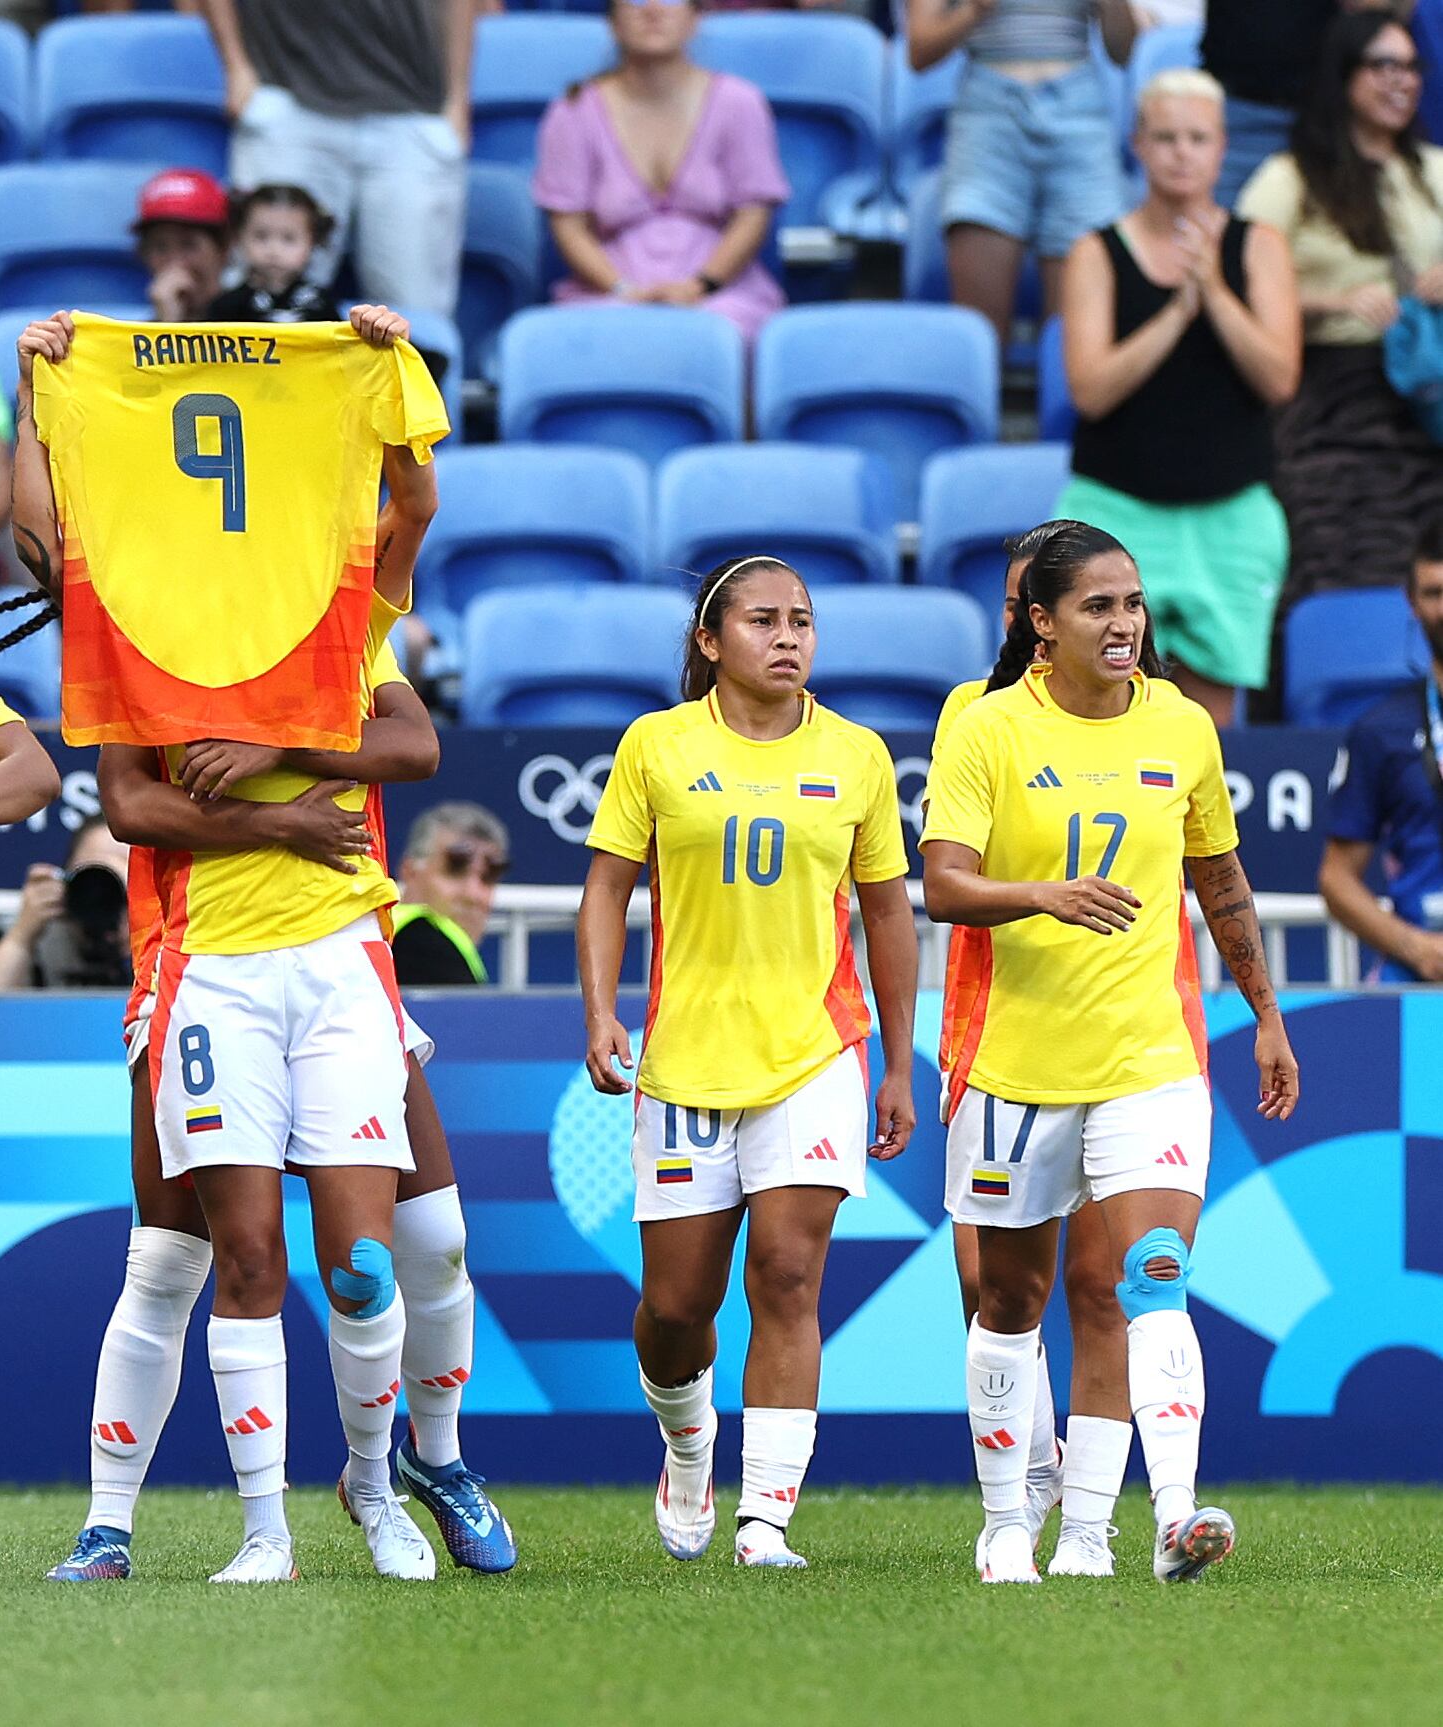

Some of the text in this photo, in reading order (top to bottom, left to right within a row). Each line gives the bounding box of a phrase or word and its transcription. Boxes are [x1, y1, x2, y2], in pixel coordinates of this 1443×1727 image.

[132, 333, 282, 367] RAMIREZ
[172, 393, 246, 533] 9
[722, 815, 785, 886] 10
[1065, 812, 1127, 881] 17
[178, 1024, 215, 1096] 8
[983, 1093, 1040, 1163] 17
